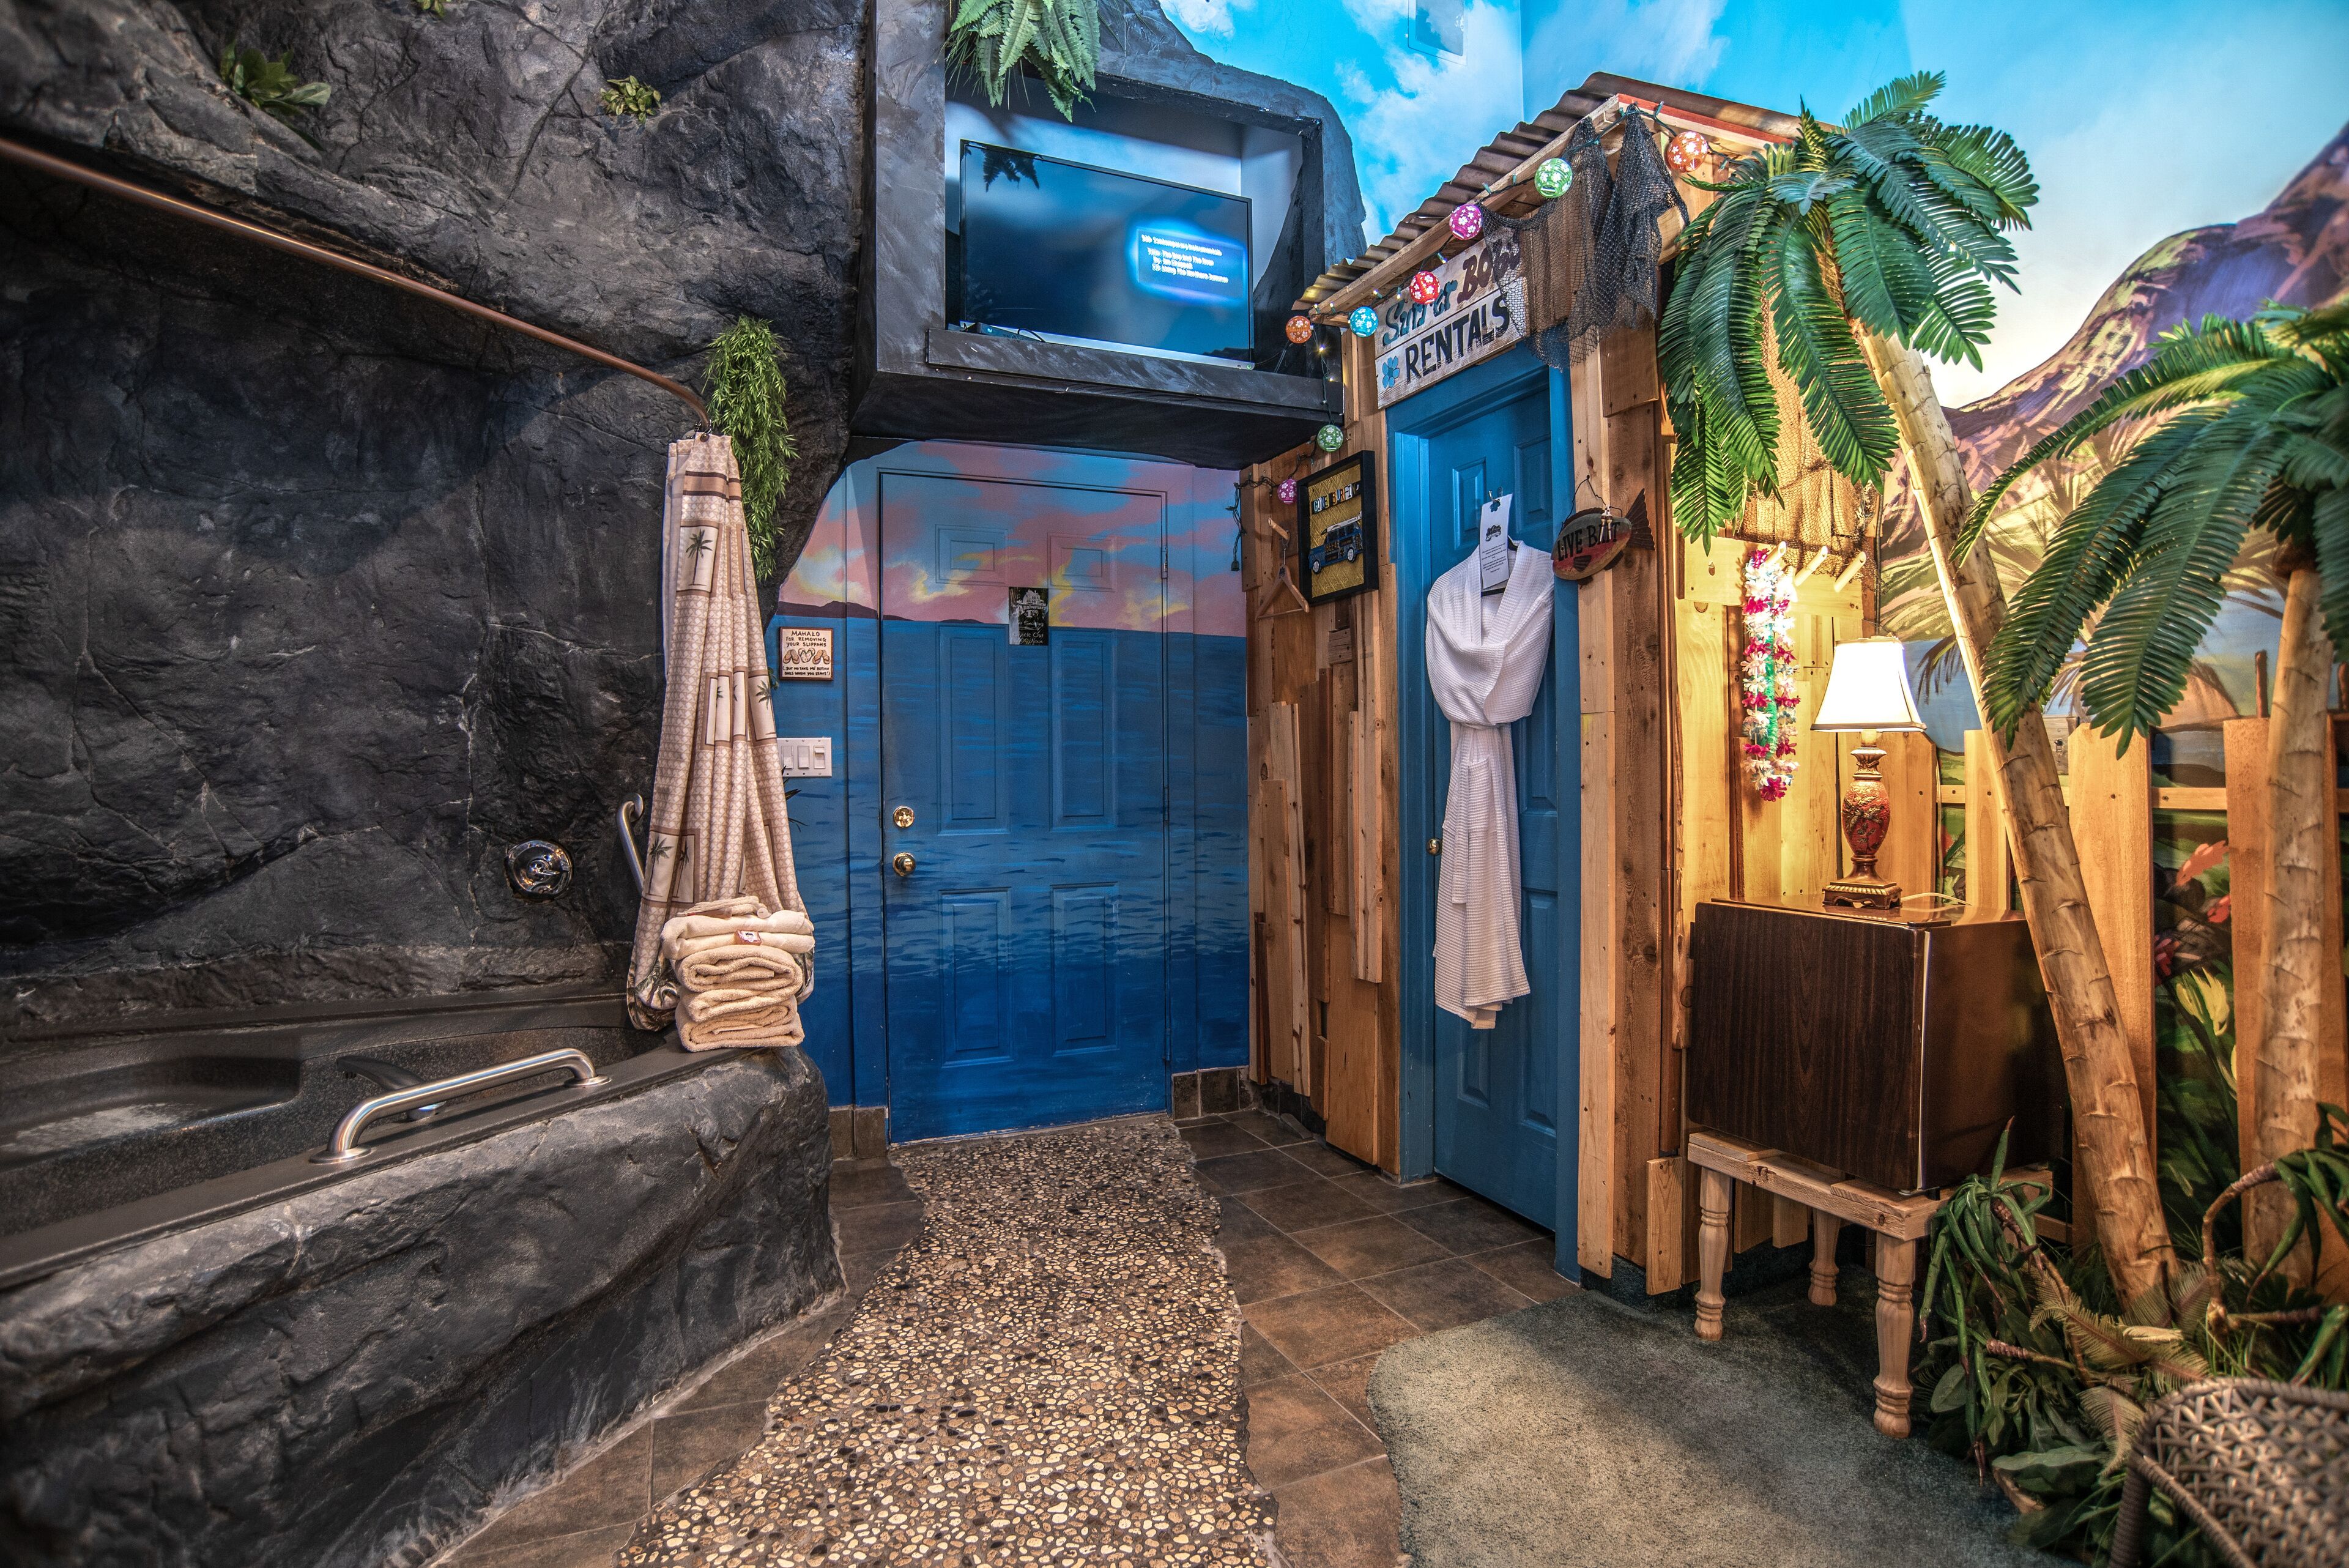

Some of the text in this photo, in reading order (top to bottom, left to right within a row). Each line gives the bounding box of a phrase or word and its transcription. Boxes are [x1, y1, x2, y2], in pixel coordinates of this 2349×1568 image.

[1405, 295, 1510, 384] RENTALS
[1313, 494, 1329, 513] GONE
[1557, 522, 1620, 562] LIVE BAIT
